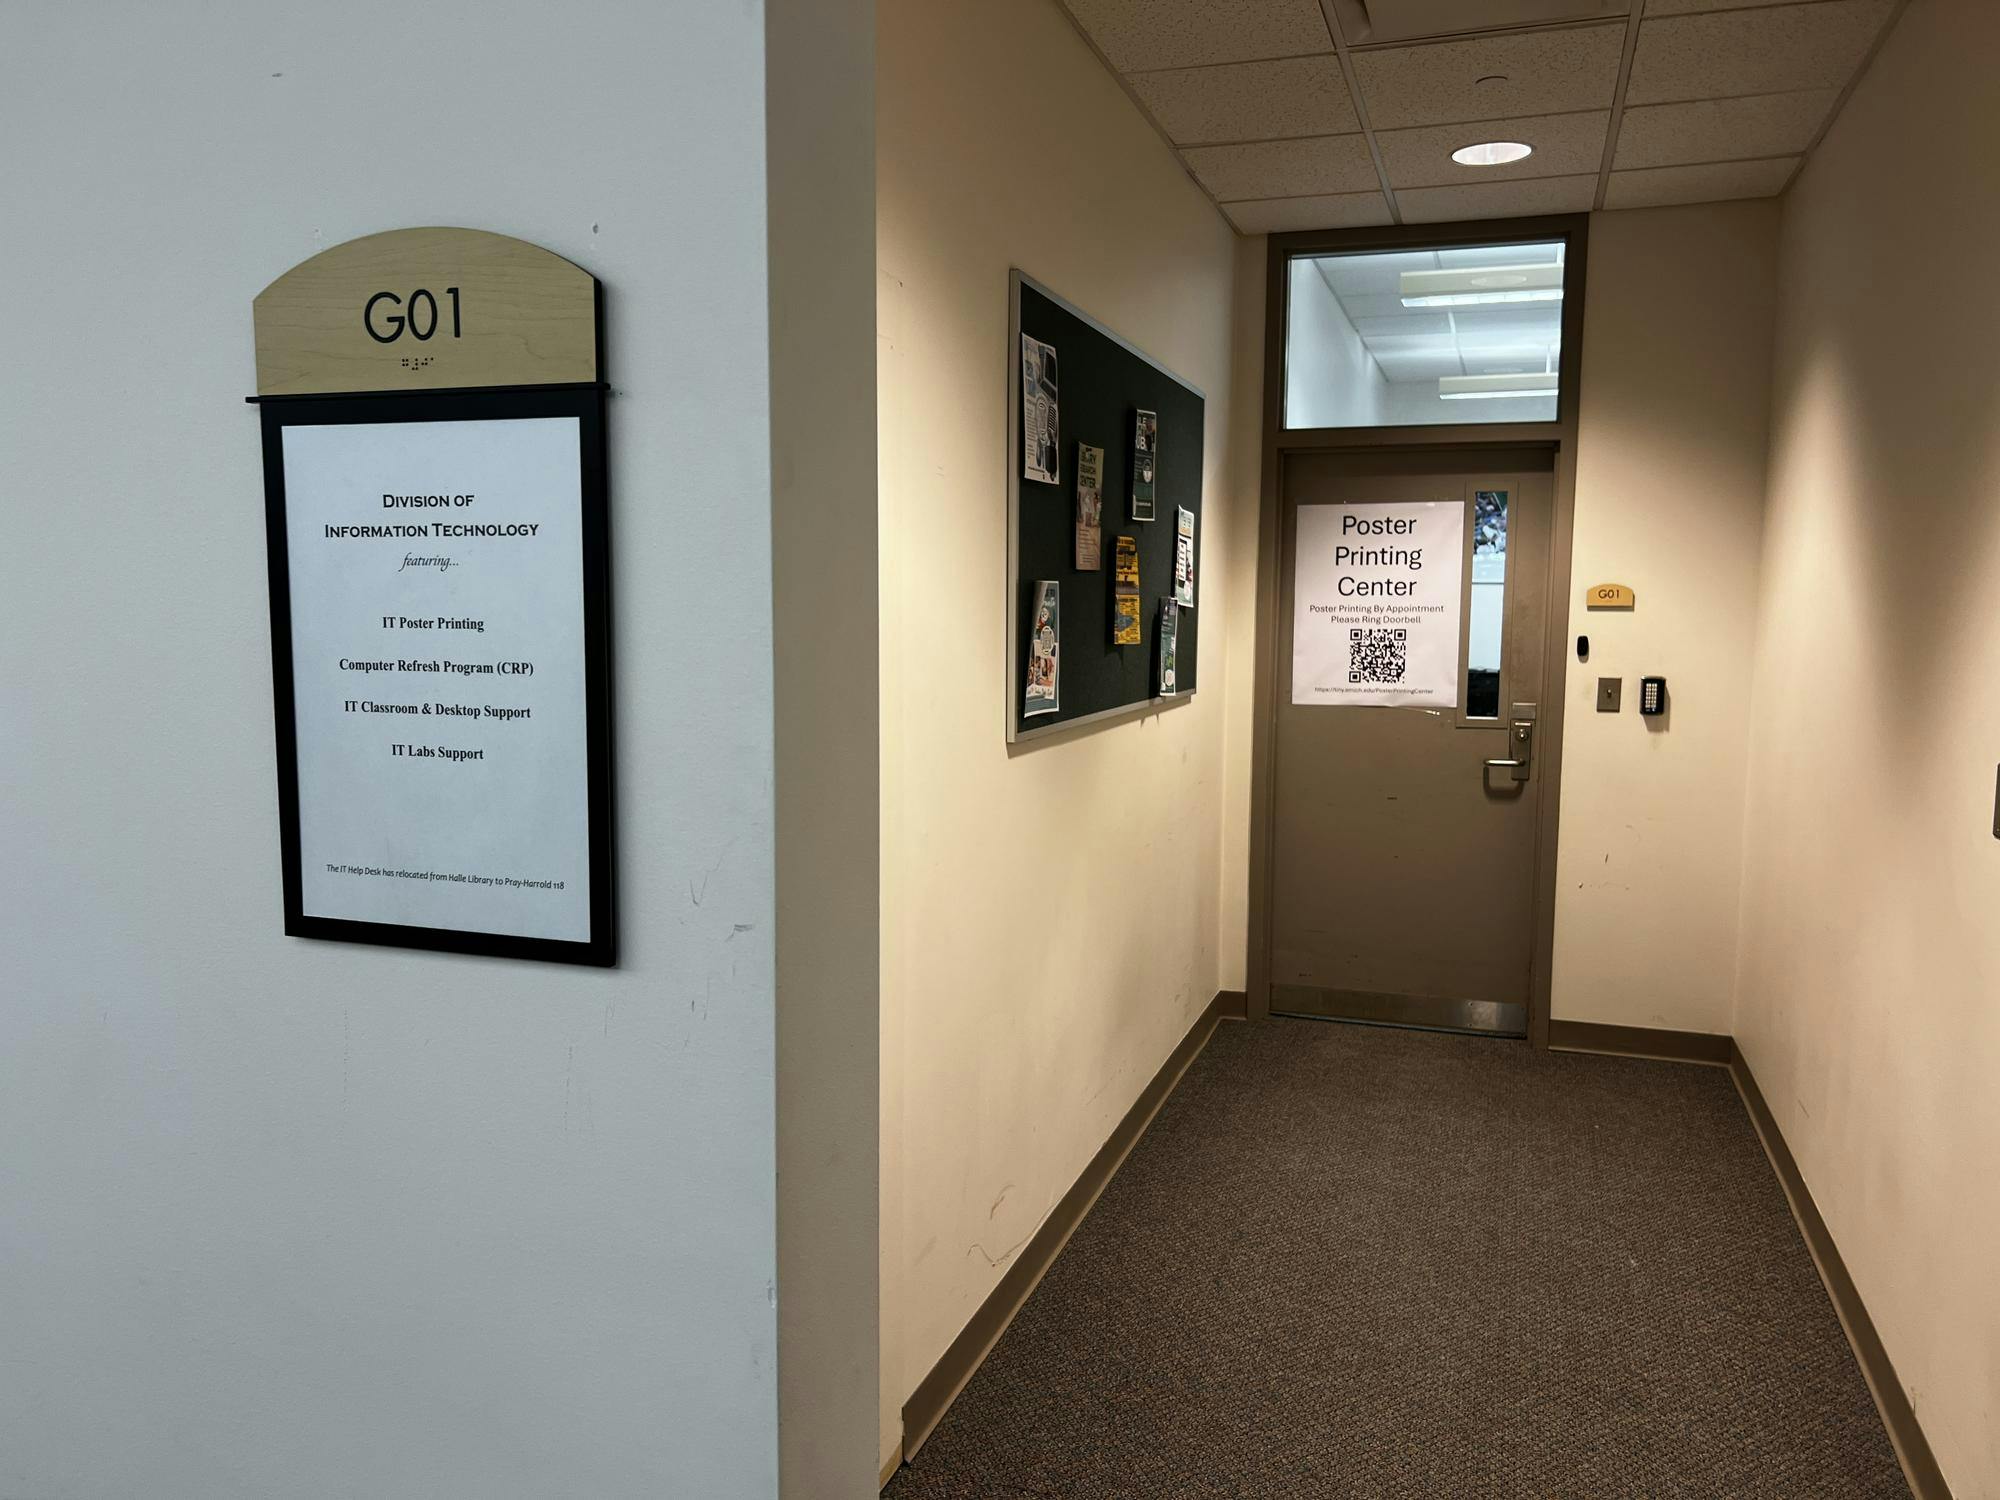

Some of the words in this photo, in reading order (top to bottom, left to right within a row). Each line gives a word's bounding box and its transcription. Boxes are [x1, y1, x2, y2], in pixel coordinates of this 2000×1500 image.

[364, 287, 461, 343] G01
[382, 494, 450, 508] DIVISION
[324, 524, 428, 538] INFORMATION
[432, 523, 539, 537] TECHNOLOGY
[1342, 514, 1417, 536] Poster
[398, 552, 459, 572] featuring...
[1335, 545, 1423, 571] Printing
[1337, 575, 1417, 597] Center
[1598, 589, 1619, 599] G01
[1309, 604, 1337, 613] Poster
[1338, 604, 1372, 614] Printing
[1373, 604, 1385, 614] By
[1386, 604, 1445, 614] Appointment
[382, 616, 397, 629] IT
[399, 616, 435, 630] Poster
[437, 617, 485, 633] Printing
[1330, 615, 1360, 624] Please
[1361, 615, 1381, 625] Ring
[1383, 615, 1421, 624] Doorbell
[339, 658, 395, 674] Computer
[397, 659, 440, 673] Refresh
[443, 661, 494, 676] Program
[497, 661, 535, 677] (CRP)
[344, 700, 359, 713] IT
[361, 701, 419, 715] Classroom
[421, 702, 432, 715] &
[434, 703, 482, 720] Desktop
[483, 704, 532, 721] Support
[391, 744, 406, 756] IT
[407, 744, 436, 758] Labs
[437, 746, 485, 762] Support
[326, 864, 340, 873] The
[340, 865, 347, 873] IT
[347, 865, 364, 877] Help
[364, 867, 382, 876] Desk
[382, 868, 395, 877] has
[395, 869, 429, 880] relocated
[429, 872, 448, 882] from
[448, 874, 467, 883] Halle
[467, 875, 494, 887] Library
[495, 878, 504, 886] to
[504, 878, 552, 889] Pray-Harrold
[552, 881, 565, 890] 118
